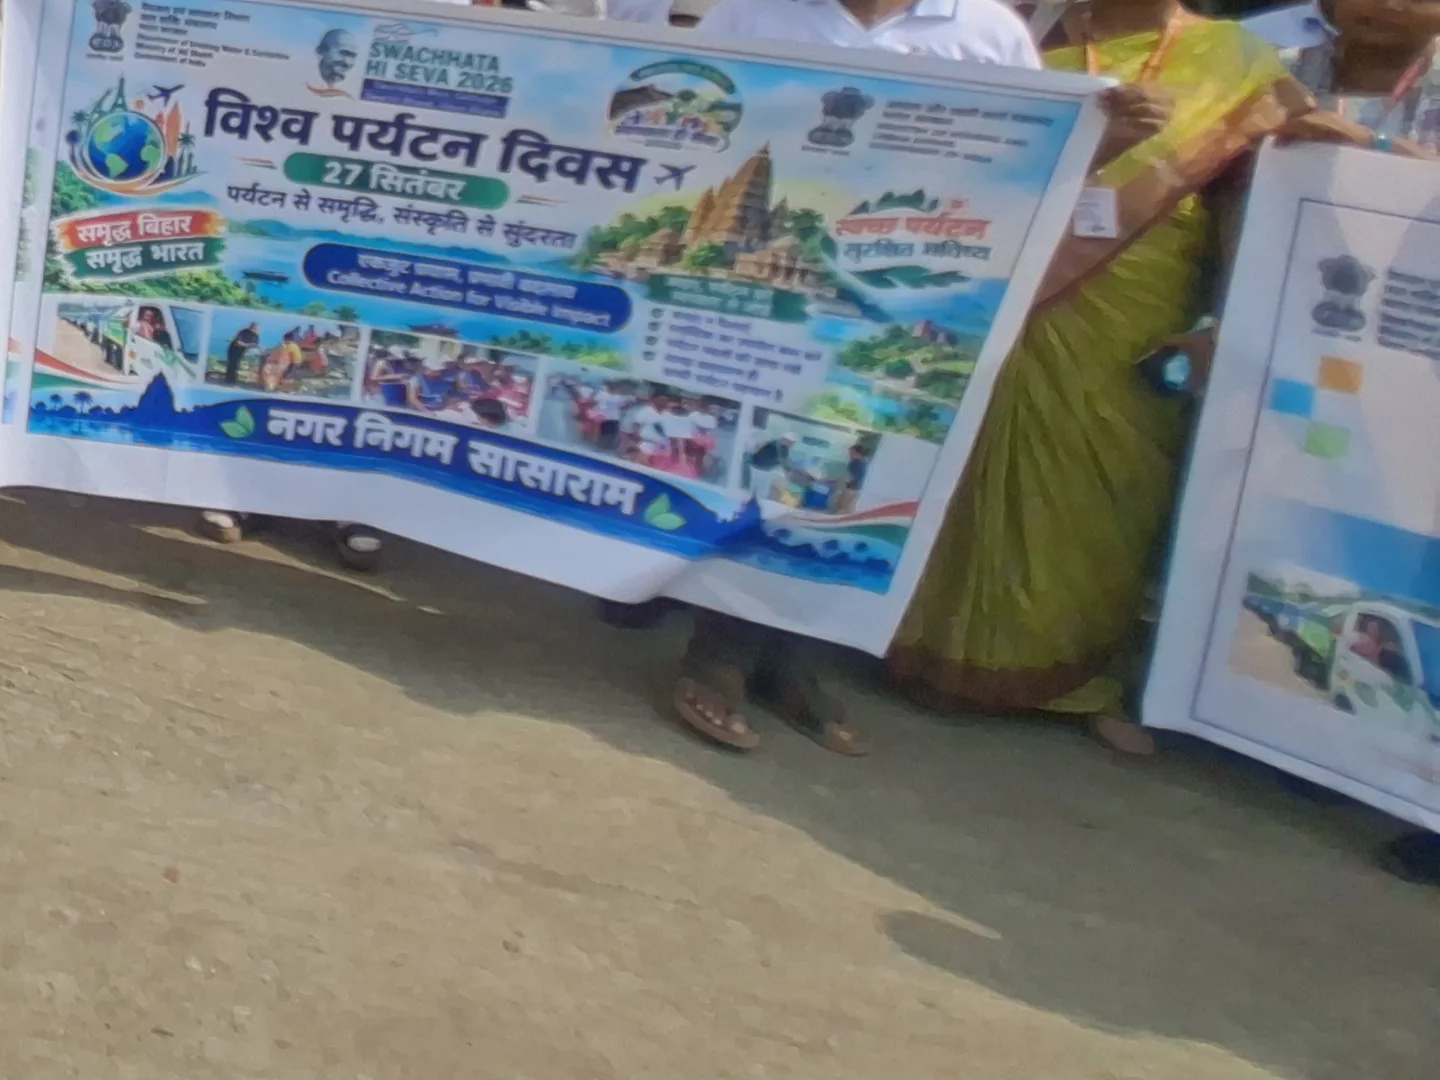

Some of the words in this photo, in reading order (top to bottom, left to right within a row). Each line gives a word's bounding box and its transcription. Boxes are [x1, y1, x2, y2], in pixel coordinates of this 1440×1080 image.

[365, 59, 388, 77] HI
[394, 63, 449, 86] SEVA
[457, 71, 514, 93] 2026
[369, 41, 500, 73] SWACHHATA
[203, 86, 319, 147] विश्व
[331, 111, 490, 170] पर्यटन
[495, 127, 648, 194] दिवस
[321, 159, 364, 187] 27
[368, 165, 467, 203] सितंबर
[76, 220, 132, 247] समृद्ध
[137, 212, 193, 236] बिहार
[227, 182, 288, 210] पर्यटन
[293, 185, 311, 211] से
[475, 213, 496, 238] से
[85, 245, 143, 273] समृद्ध
[150, 242, 205, 263] भारत
[267, 407, 347, 447] नगर
[353, 411, 459, 466] निगम
[466, 437, 645, 516] सासाराम
